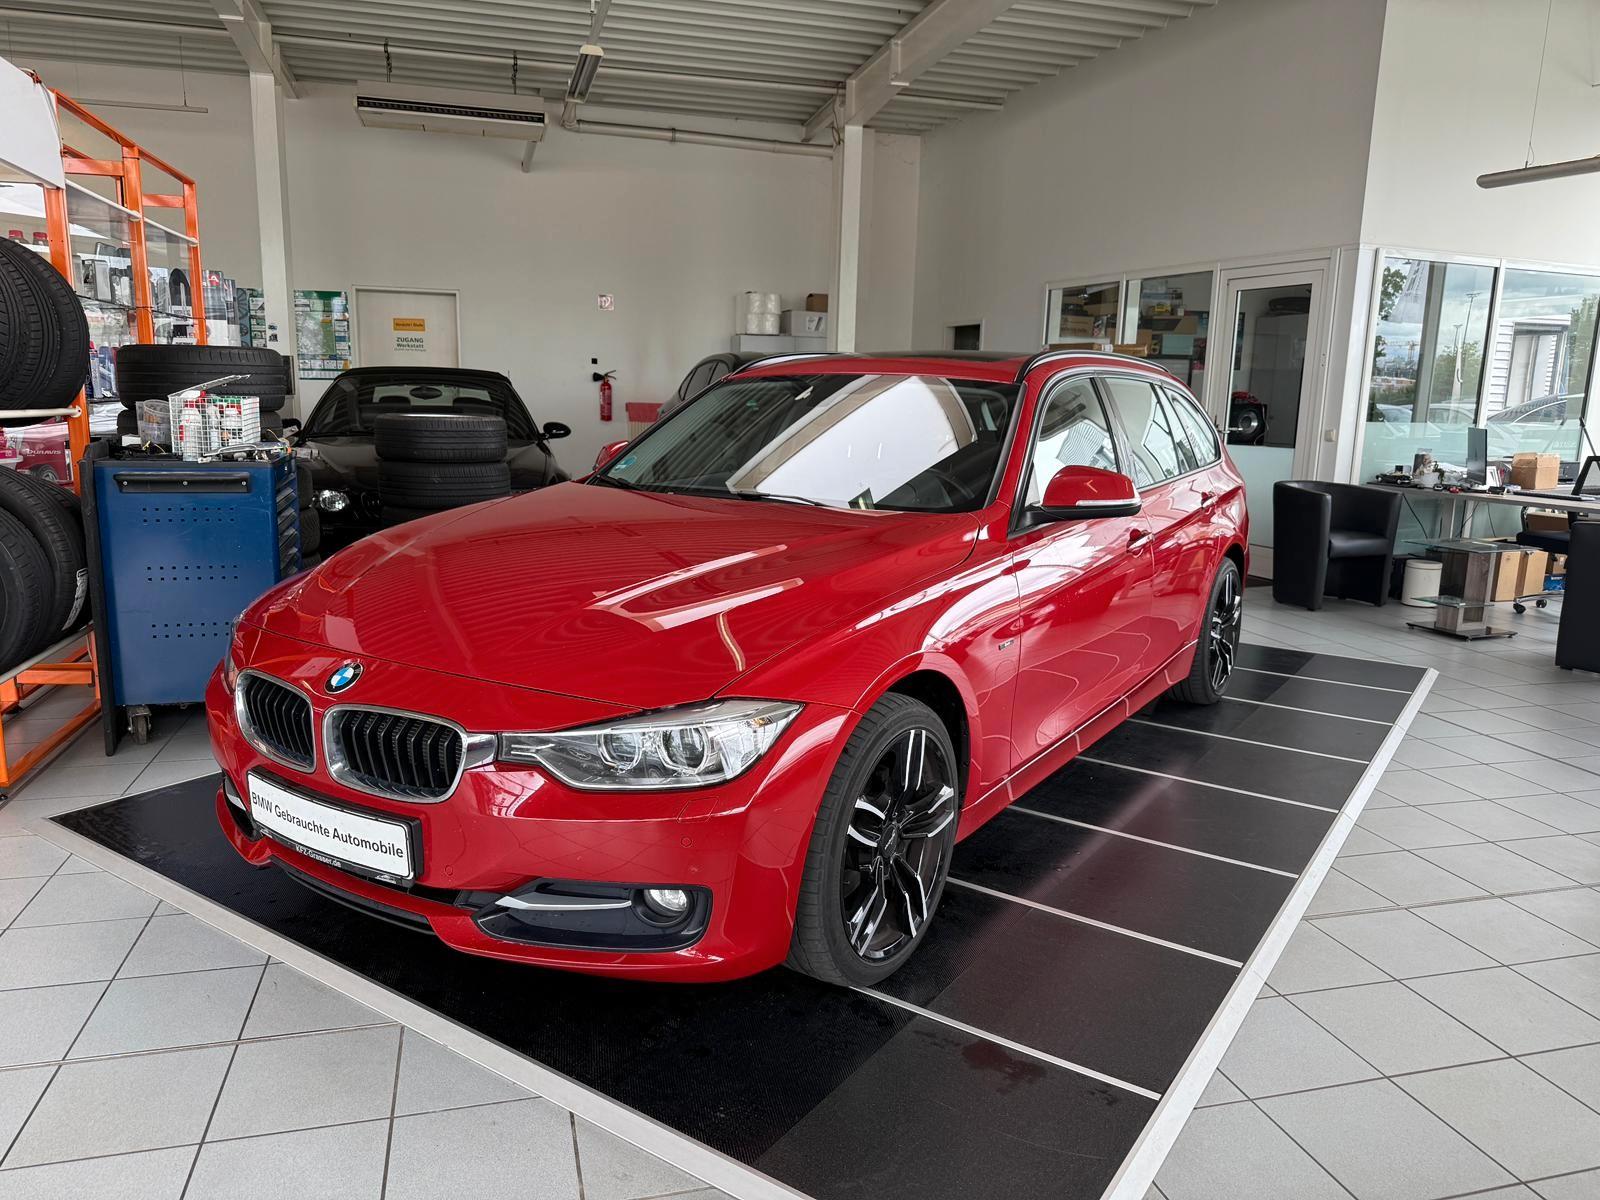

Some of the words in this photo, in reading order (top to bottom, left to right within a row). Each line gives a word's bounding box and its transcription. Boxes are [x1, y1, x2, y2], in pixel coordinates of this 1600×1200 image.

[251, 791, 273, 814] BMW
[274, 804, 330, 838] Gebrauchte
[332, 827, 404, 858] Automobile
